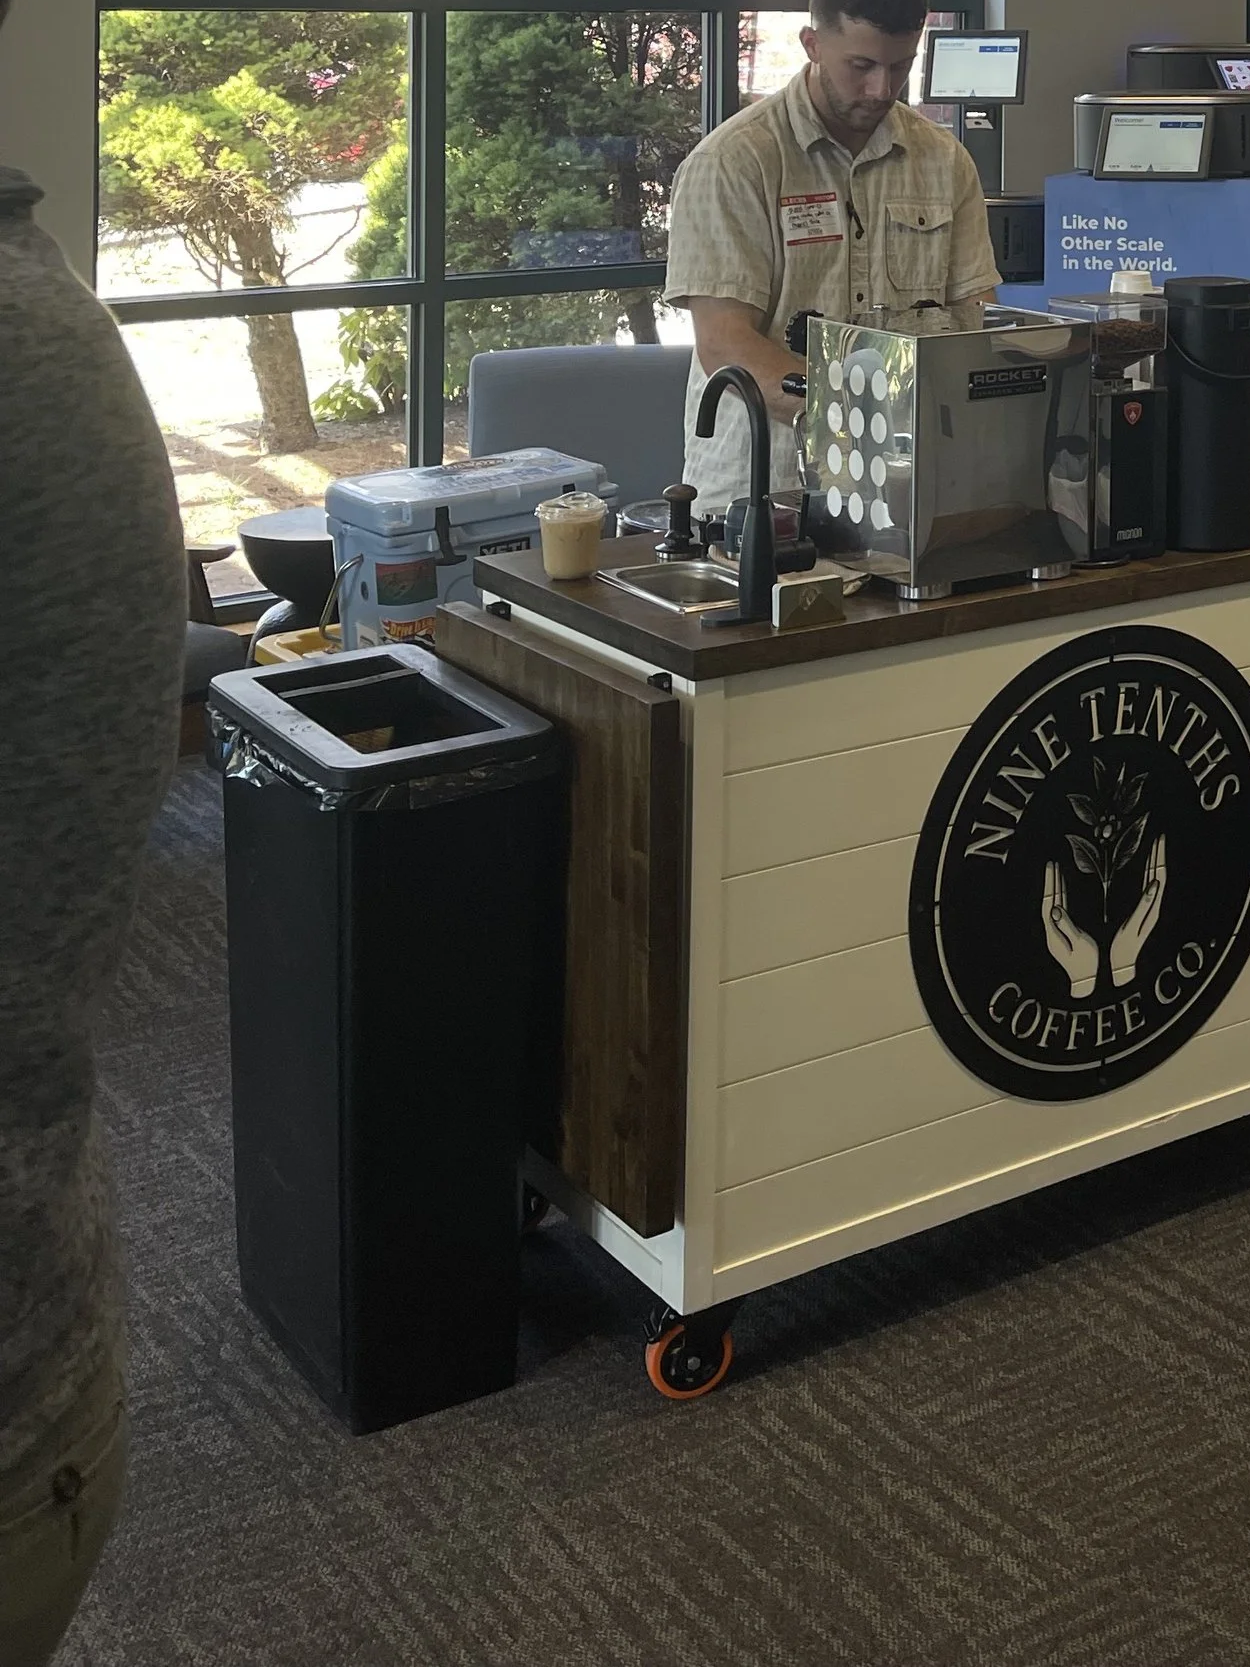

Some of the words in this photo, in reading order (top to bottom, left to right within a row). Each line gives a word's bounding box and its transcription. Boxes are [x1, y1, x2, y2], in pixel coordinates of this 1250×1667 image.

[1062, 215, 1098, 230] Like
[1104, 216, 1128, 230] No
[1061, 237, 1112, 251] Other
[1117, 238, 1164, 252] Scale
[1063, 256, 1079, 270] in
[1084, 256, 1114, 271] the
[1119, 257, 1177, 272] World.
[973, 369, 1042, 385] ROCKET
[964, 712, 1072, 864] NINE
[1080, 681, 1240, 812] TENTHS
[989, 981, 1146, 1051] COFFEE
[1153, 938, 1217, 1006] CO.
